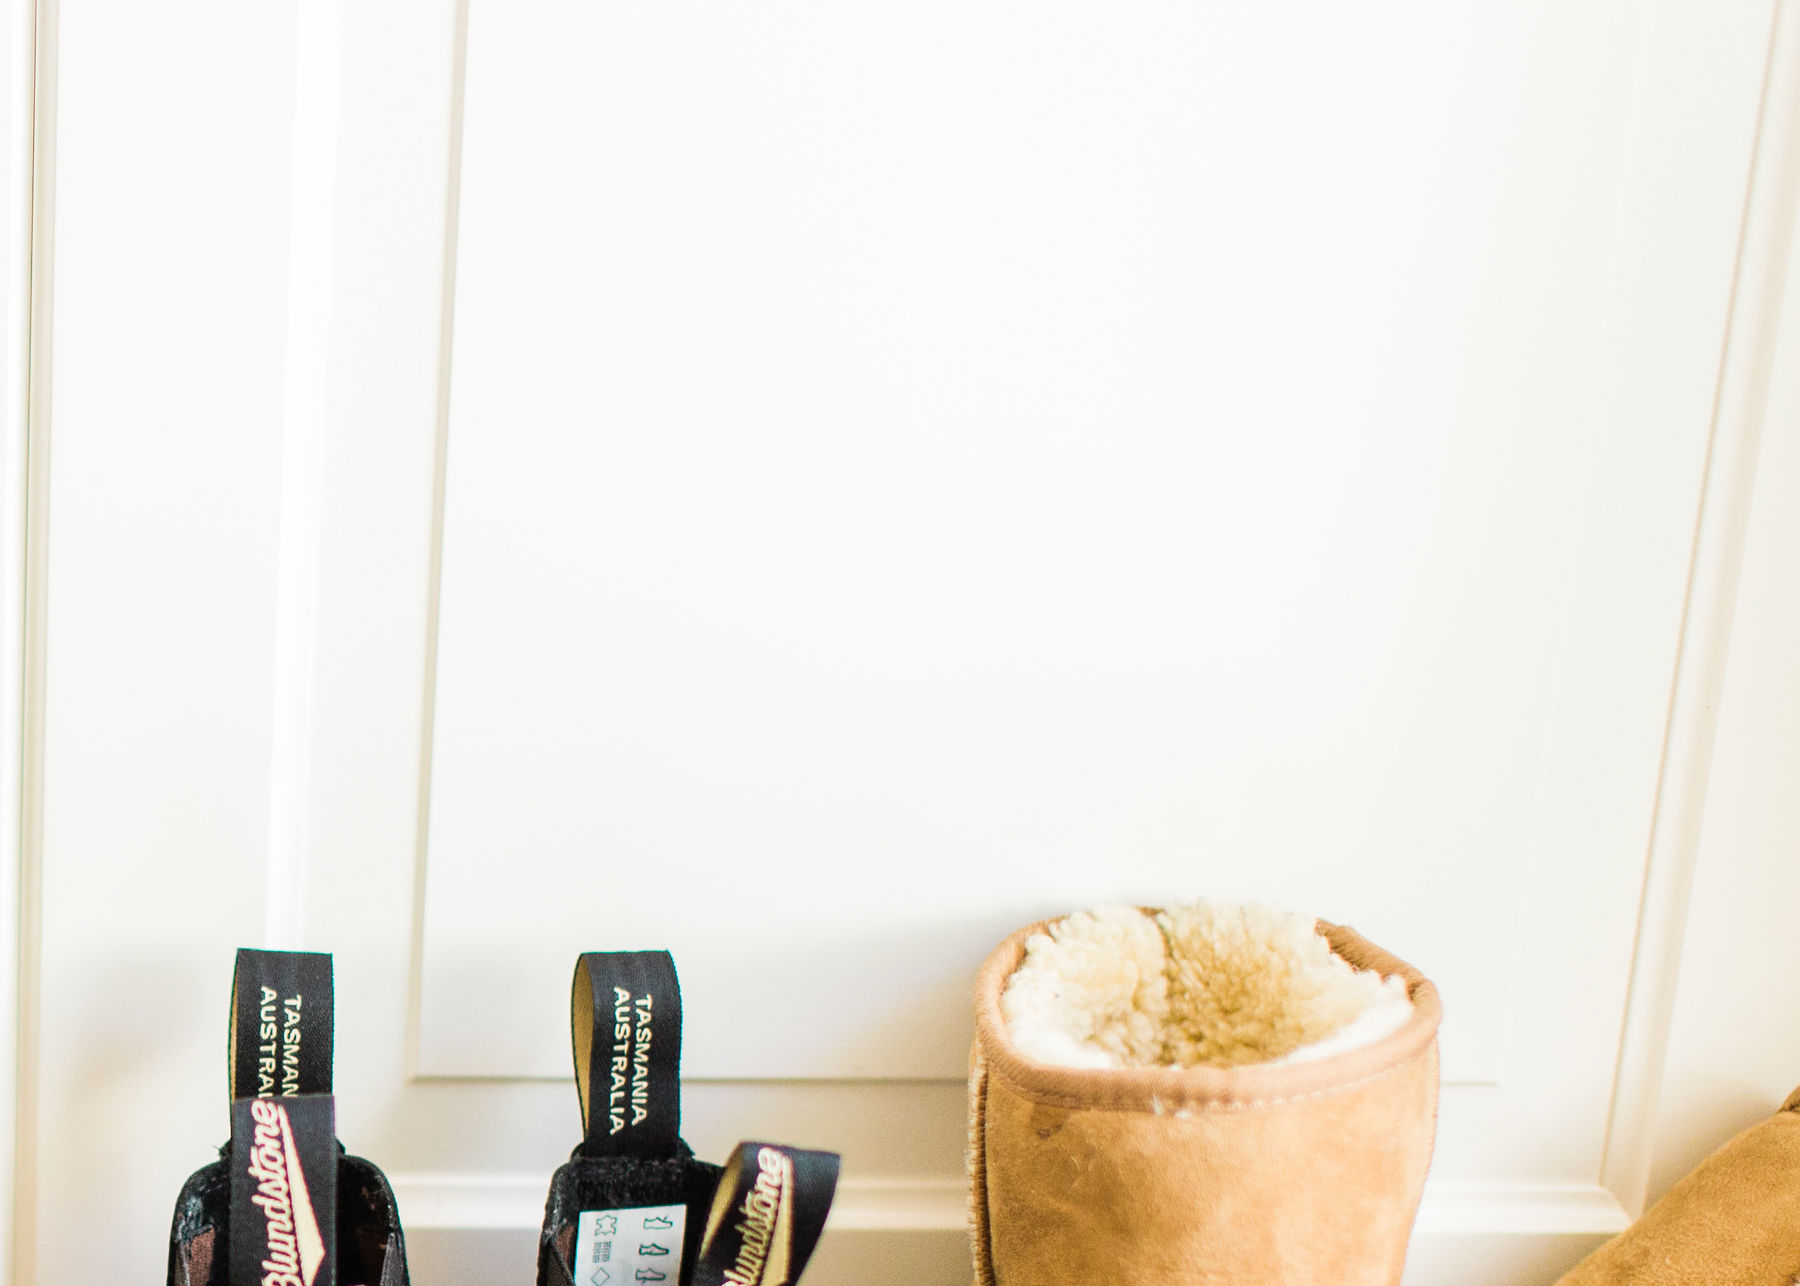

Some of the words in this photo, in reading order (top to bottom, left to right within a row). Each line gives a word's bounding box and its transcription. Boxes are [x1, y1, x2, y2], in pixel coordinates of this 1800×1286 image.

[258, 985, 277, 1099] AUSTRAL
[282, 994, 302, 1098] TASMAN
[609, 987, 631, 1135] AUSTRALIA
[631, 994, 653, 1125] TASMANIA
